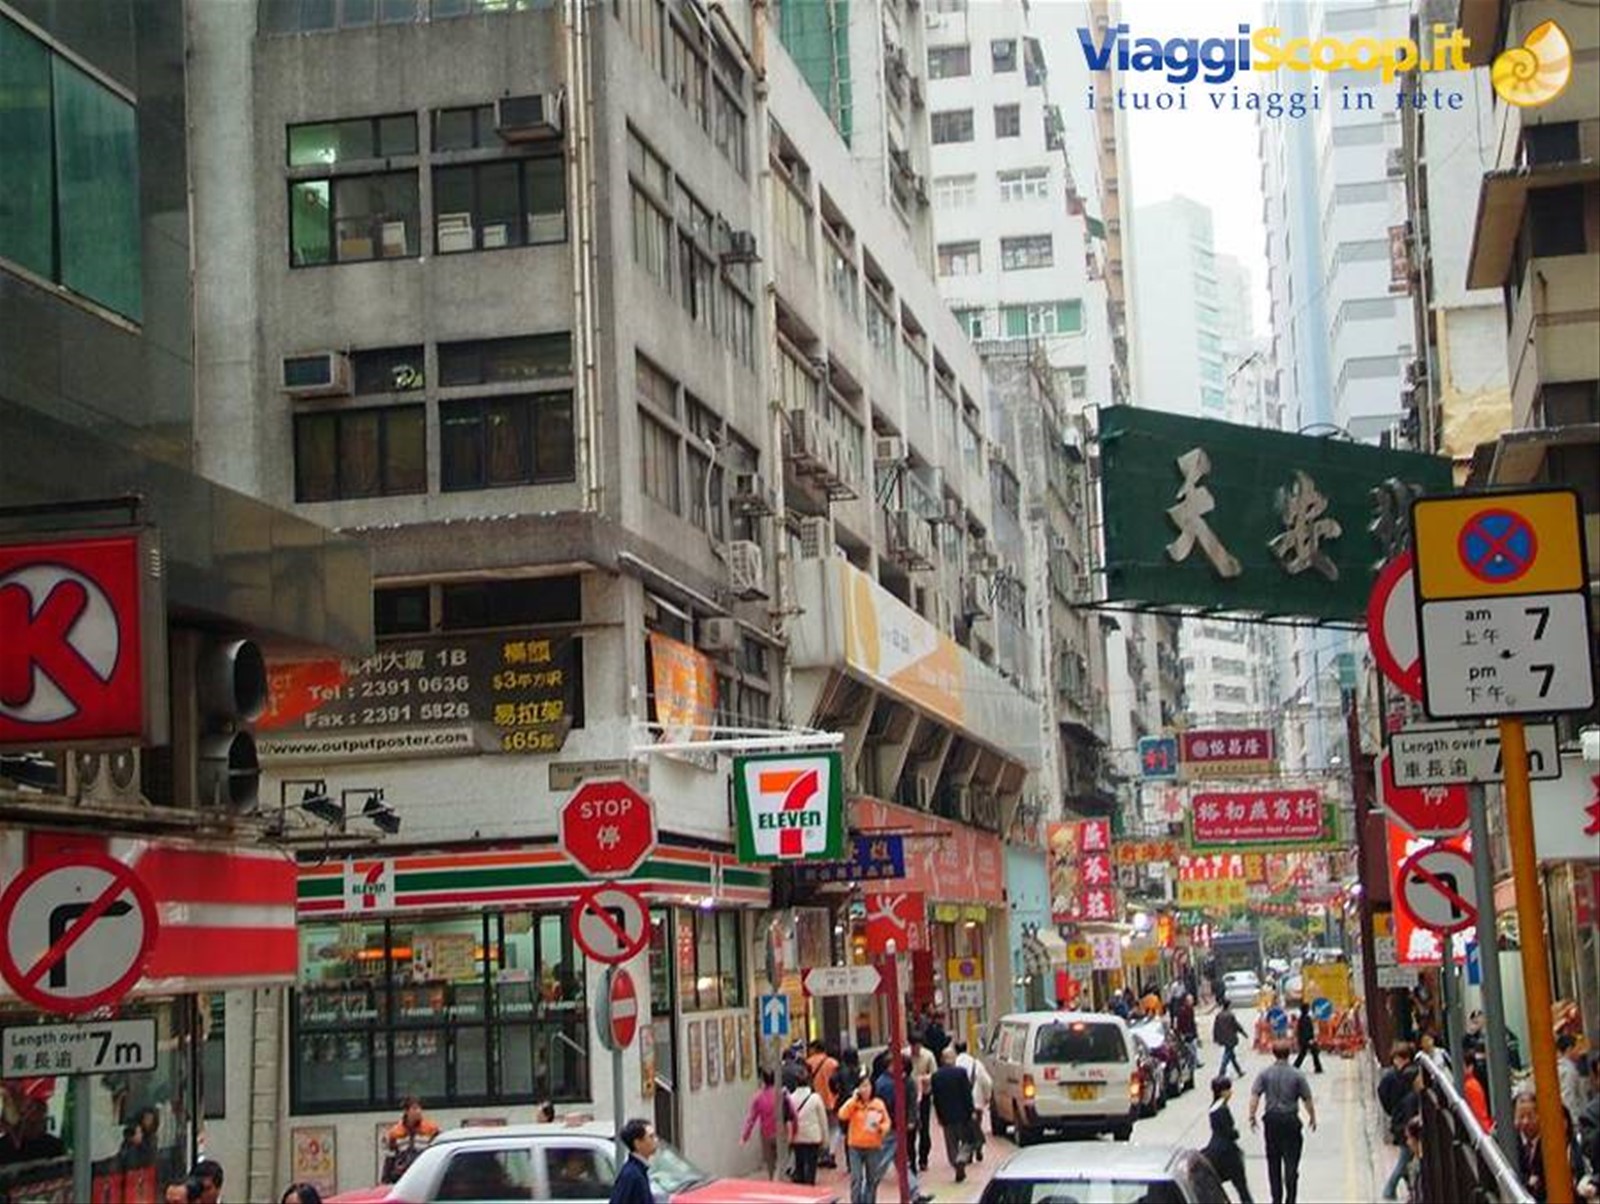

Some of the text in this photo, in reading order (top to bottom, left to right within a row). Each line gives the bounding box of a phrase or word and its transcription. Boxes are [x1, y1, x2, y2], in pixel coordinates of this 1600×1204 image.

[1465, 606, 1550, 640] am 7
[1460, 628, 1500, 645] 上午
[437, 650, 467, 667] 1B
[362, 679, 410, 697] 2391
[1469, 663, 1555, 698] pm 7
[1465, 685, 1505, 703] 下午
[305, 712, 344, 729] Fax
[363, 705, 411, 724] 2391
[1401, 737, 1449, 755] Length
[1452, 740, 1483, 751] over
[581, 799, 633, 819] STOP
[597, 825, 621, 850] 停
[11, 1031, 57, 1047] Length
[59, 1032, 88, 1044] over
